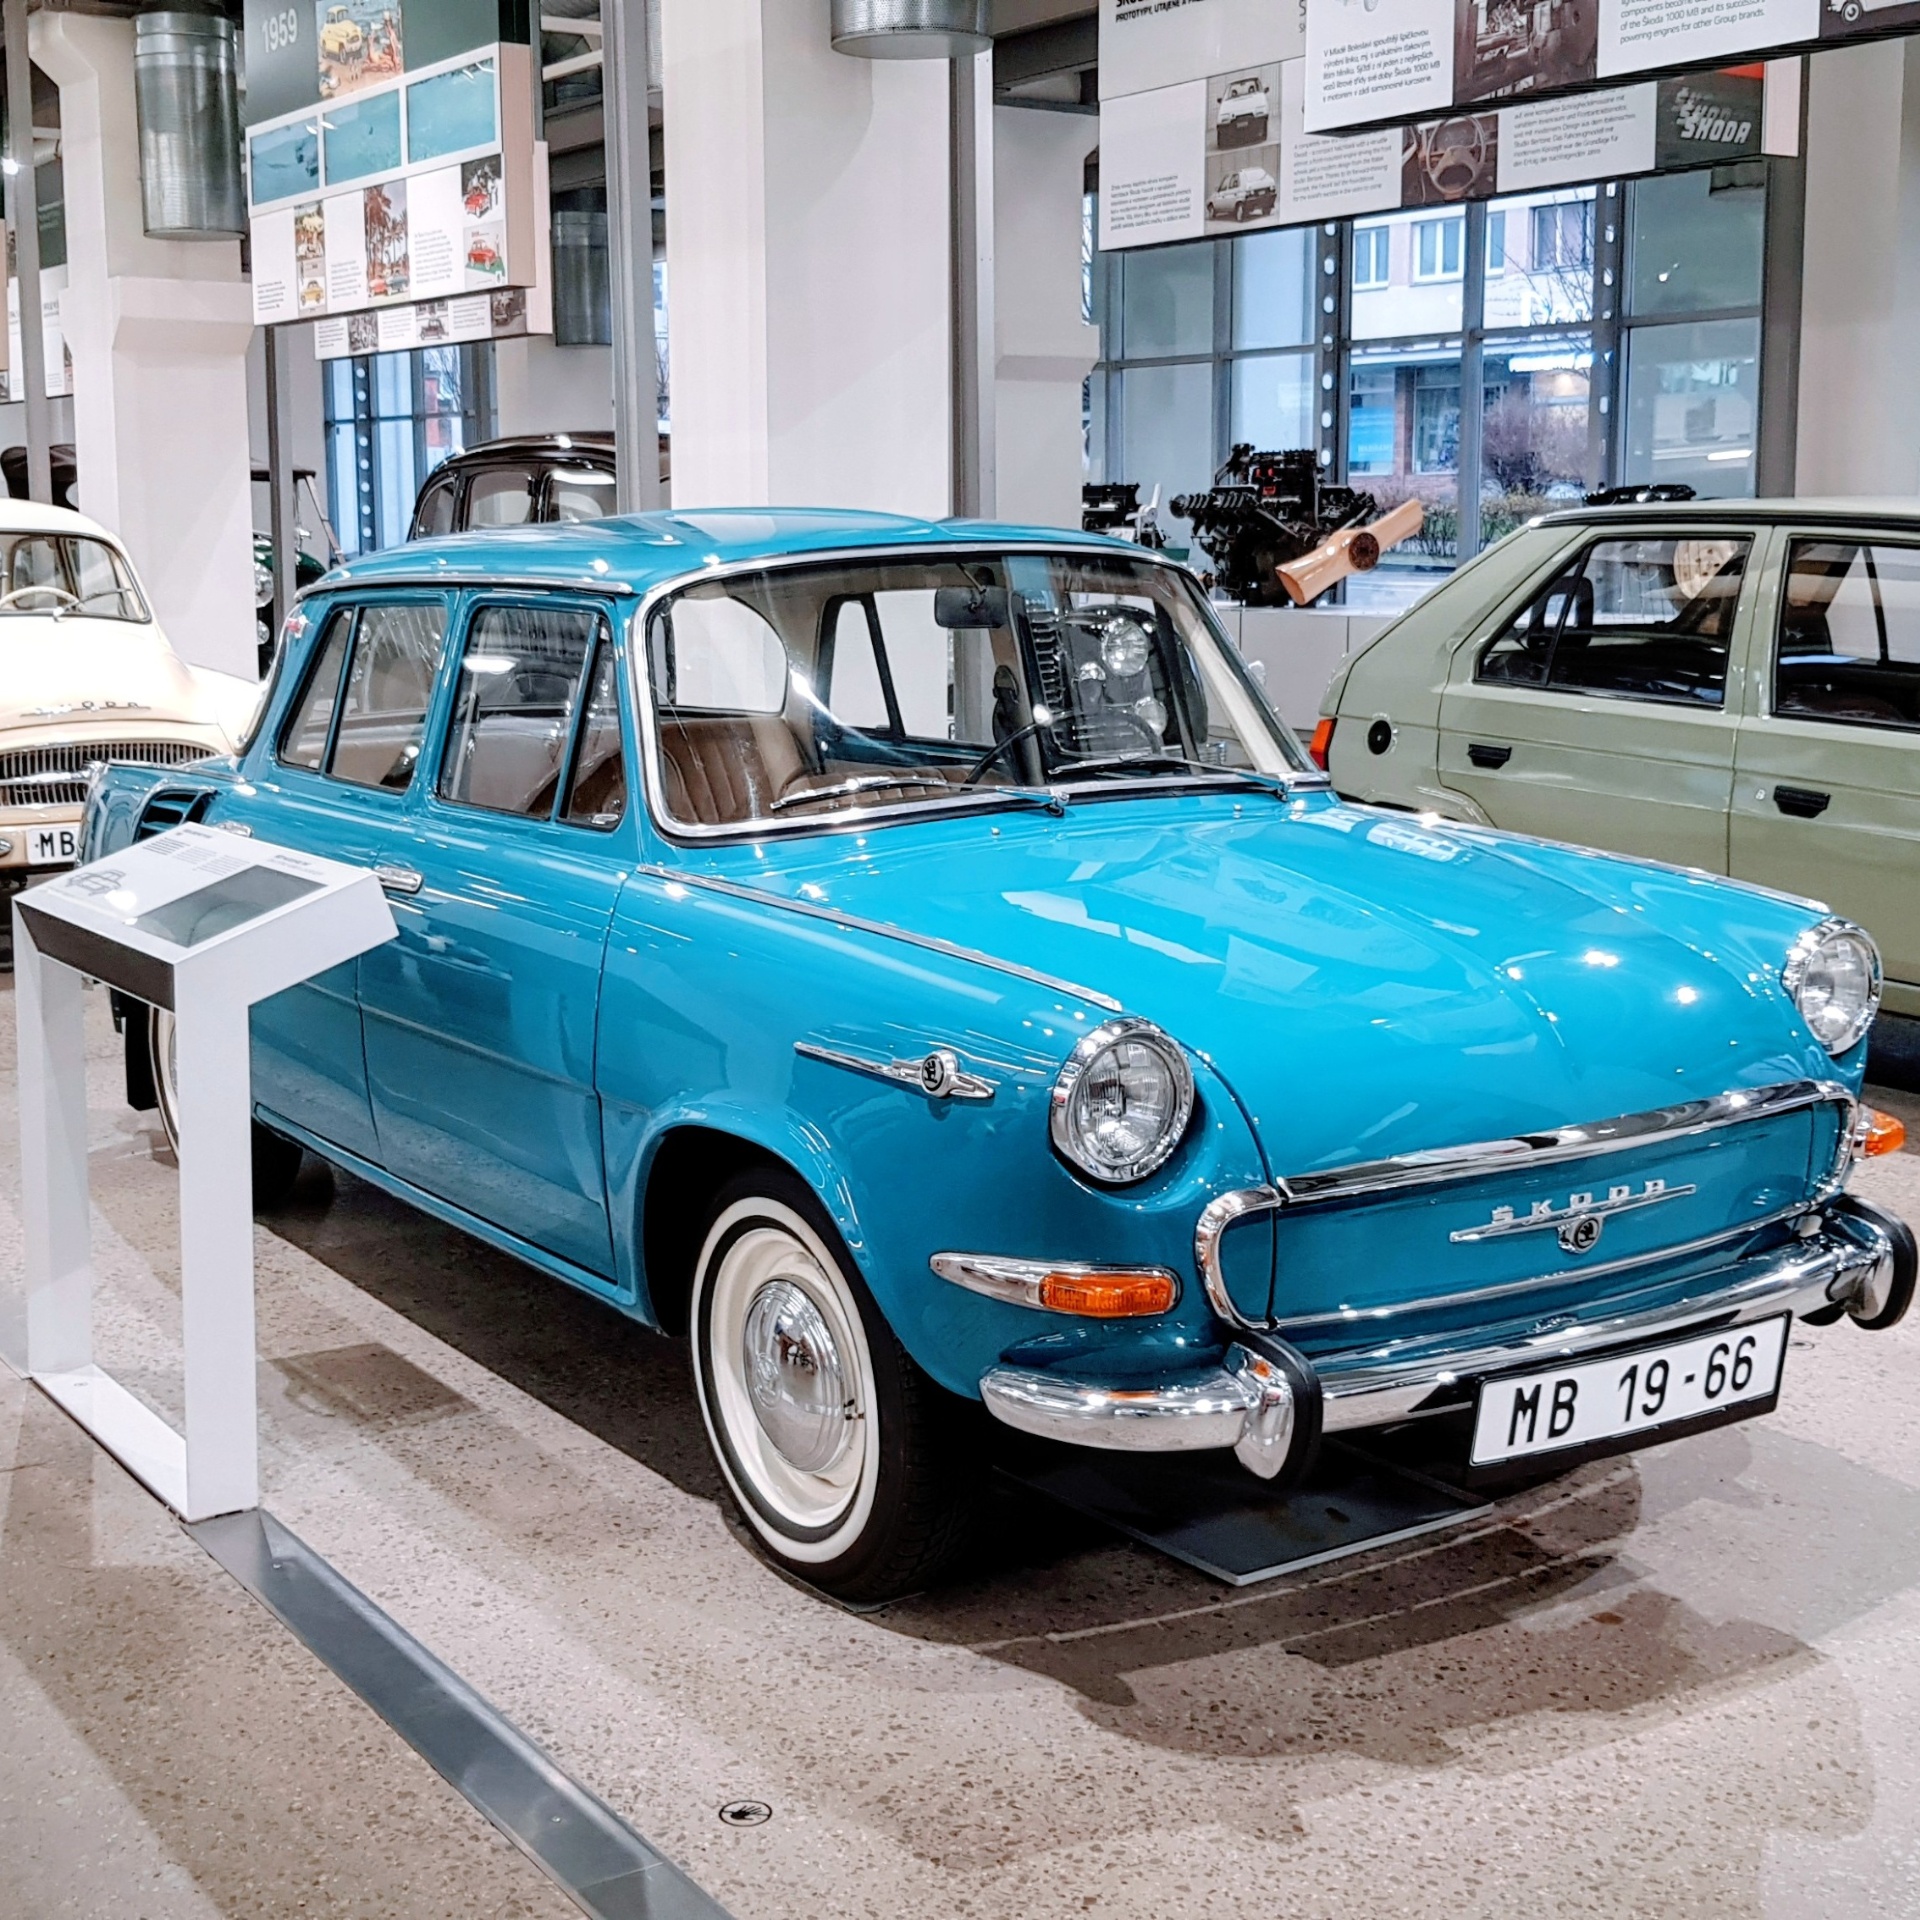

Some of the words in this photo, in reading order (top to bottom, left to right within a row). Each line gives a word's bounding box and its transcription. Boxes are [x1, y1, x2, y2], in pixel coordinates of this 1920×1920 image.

[1620, 3, 1663, 18] components
[1620, 21, 1627, 31] of
[1629, 21, 1640, 29] the
[1642, 15, 1663, 26] Škoda
[1666, 10, 1684, 21] 1000
[1686, 7, 1699, 17] MB
[1700, 4, 1714, 15] and
[262, 8, 297, 53] 1959
[1620, 31, 1652, 45] powering
[1653, 26, 1680, 37] engines
[1681, 23, 1692, 31] for
[1692, 19, 1712, 29] other
[1714, 14, 1737, 25] Group
[39, 831, 75, 858] MB
[1507, 1379, 1578, 1447] MB
